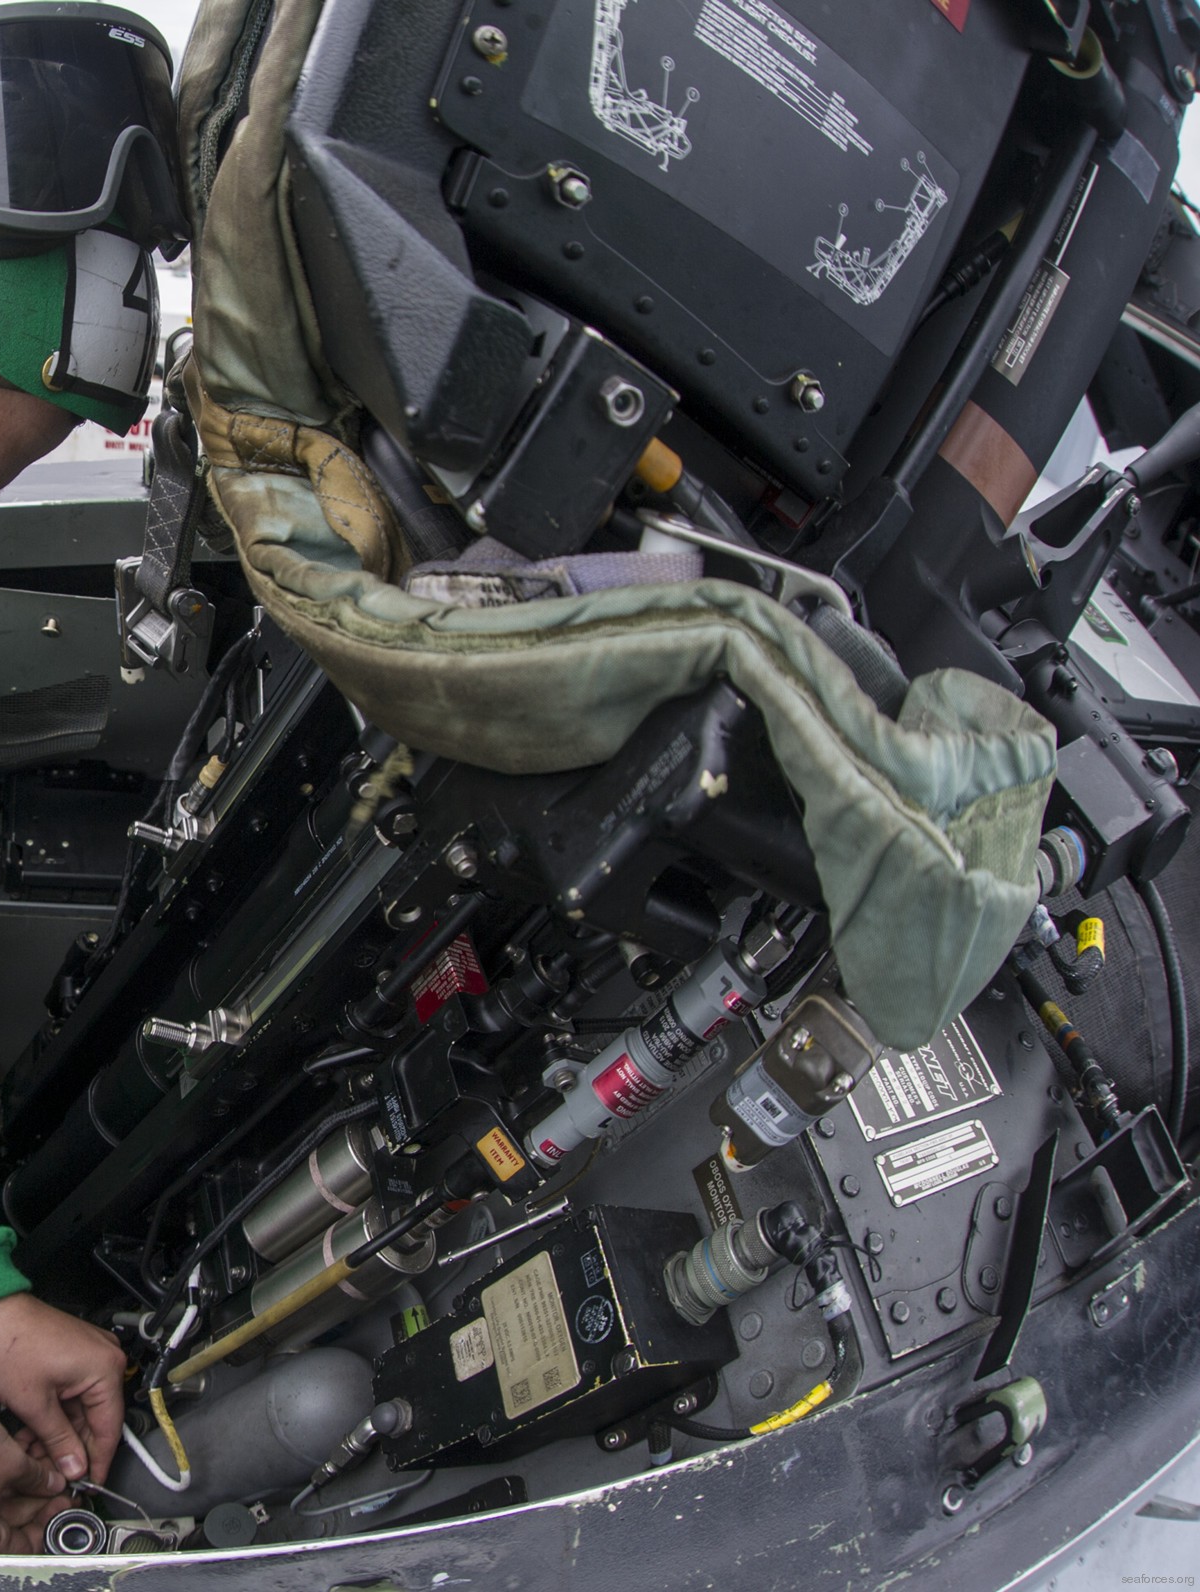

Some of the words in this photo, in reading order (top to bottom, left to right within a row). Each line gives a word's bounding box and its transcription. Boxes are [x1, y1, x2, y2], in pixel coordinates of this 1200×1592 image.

[748, 0, 795, 35] JECTION
[793, 29, 818, 52] SEAT
[108, 26, 145, 47] ESS
[726, 996, 751, 1014] TLET
[666, 1029, 679, 1043] SEP
[642, 1029, 665, 1062] ACTUATED
[615, 1066, 626, 1079] NOT
[612, 1089, 621, 1098] BY
[624, 1078, 640, 1093] SHALL
[881, 1076, 893, 1094] PART
[489, 1148, 504, 1165] ITEM
[491, 1131, 519, 1167] WARRANTY
[708, 1159, 726, 1193] OBOGS
[706, 1180, 727, 1225] MONITOR
